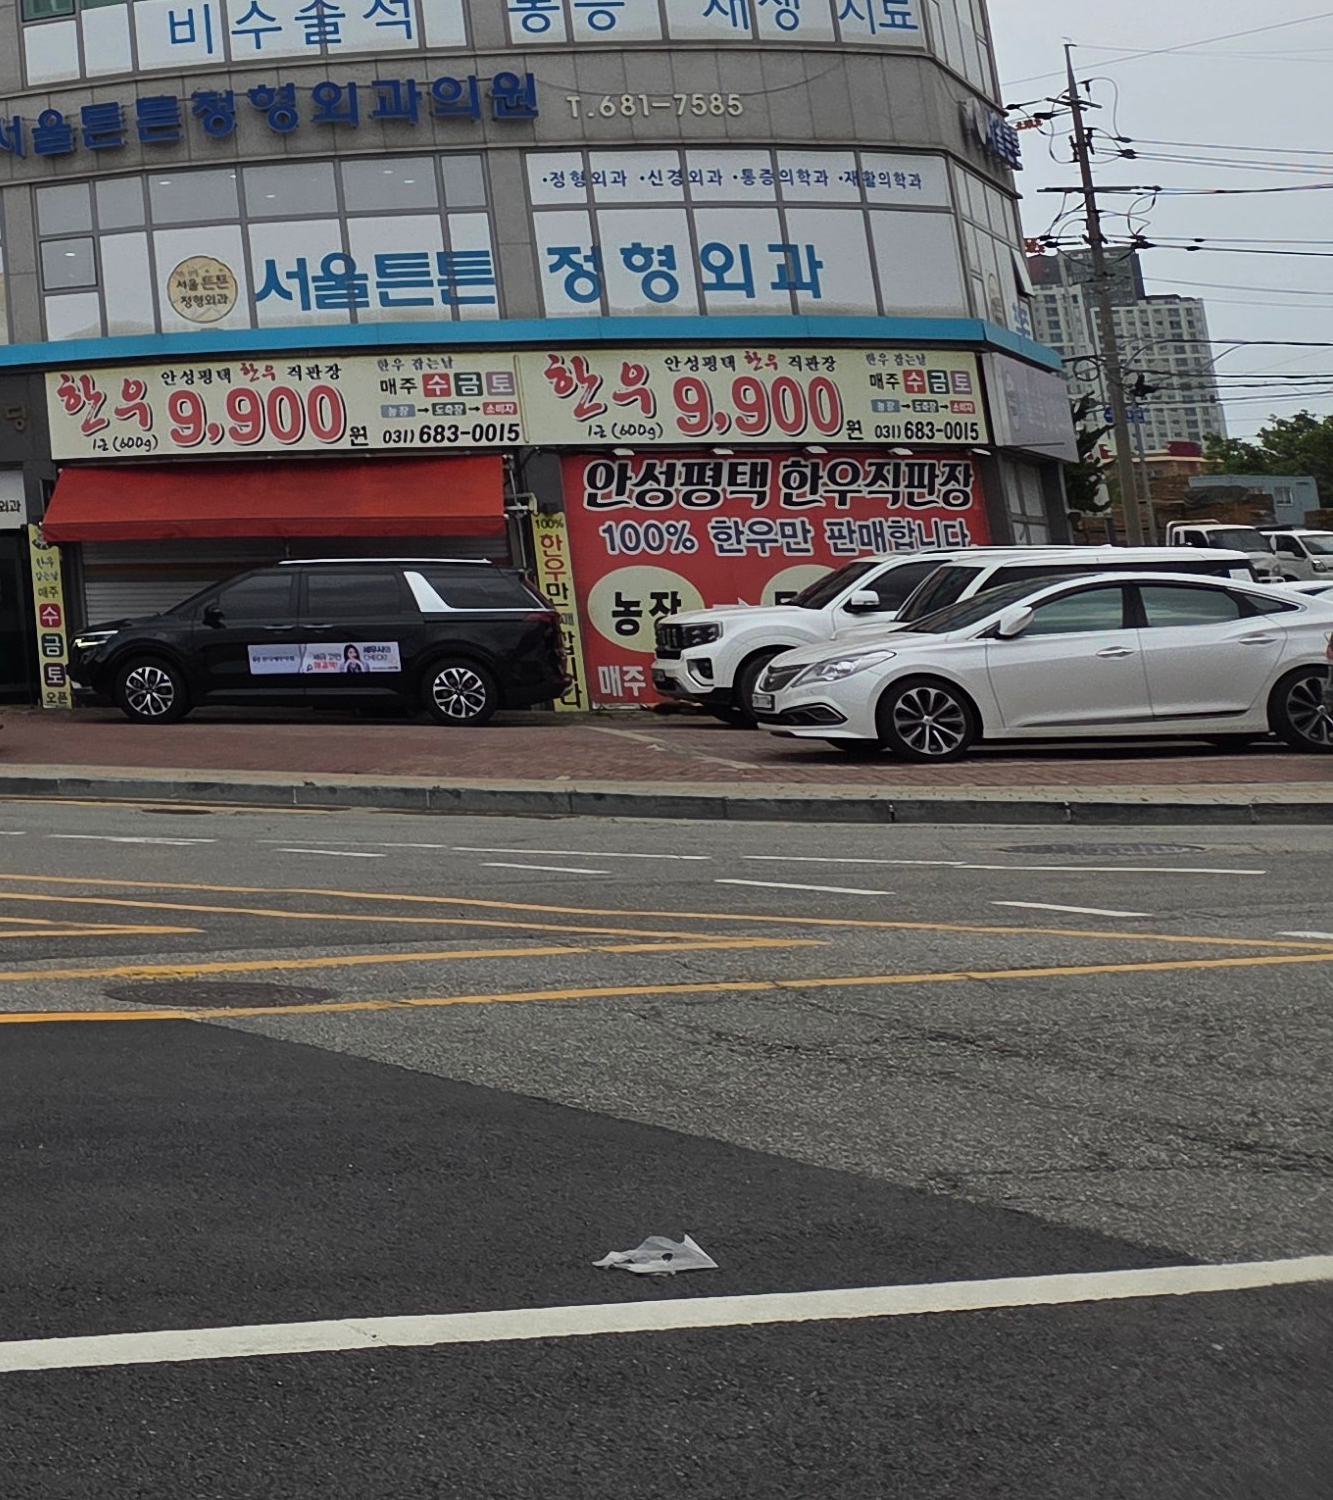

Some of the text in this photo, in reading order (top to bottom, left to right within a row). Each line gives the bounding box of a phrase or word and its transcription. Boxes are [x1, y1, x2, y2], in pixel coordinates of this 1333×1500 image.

[565, 92, 745, 120] T.681-7585
[175, 273, 231, 292] 서울 튼튼
[546, 241, 825, 304] 정형외과
[179, 292, 230, 310] 정형외과
[663, 349, 837, 373] 안성평택 한우 직판장
[160, 361, 343, 386] 안성평택 한우 직판장
[379, 372, 513, 397] 매주 수 금 토
[868, 370, 972, 393] 매주 수 금 토
[543, 353, 657, 421] 한우
[56, 373, 153, 436] 한우
[167, 382, 370, 448] 9,900 원
[672, 375, 865, 441] 9,900 원
[419, 423, 521, 444] 683-0015
[903, 420, 980, 442] 683-0015
[583, 457, 976, 511] 안성평택 한우직판장
[534, 517, 565, 530] 100%
[599, 517, 971, 558] 100% 한우만 판매합니다
[37, 585, 59, 600] 매주
[40, 605, 62, 626] 수
[42, 635, 63, 658] 금
[46, 666, 65, 685] 토
[597, 663, 647, 700] 매주
